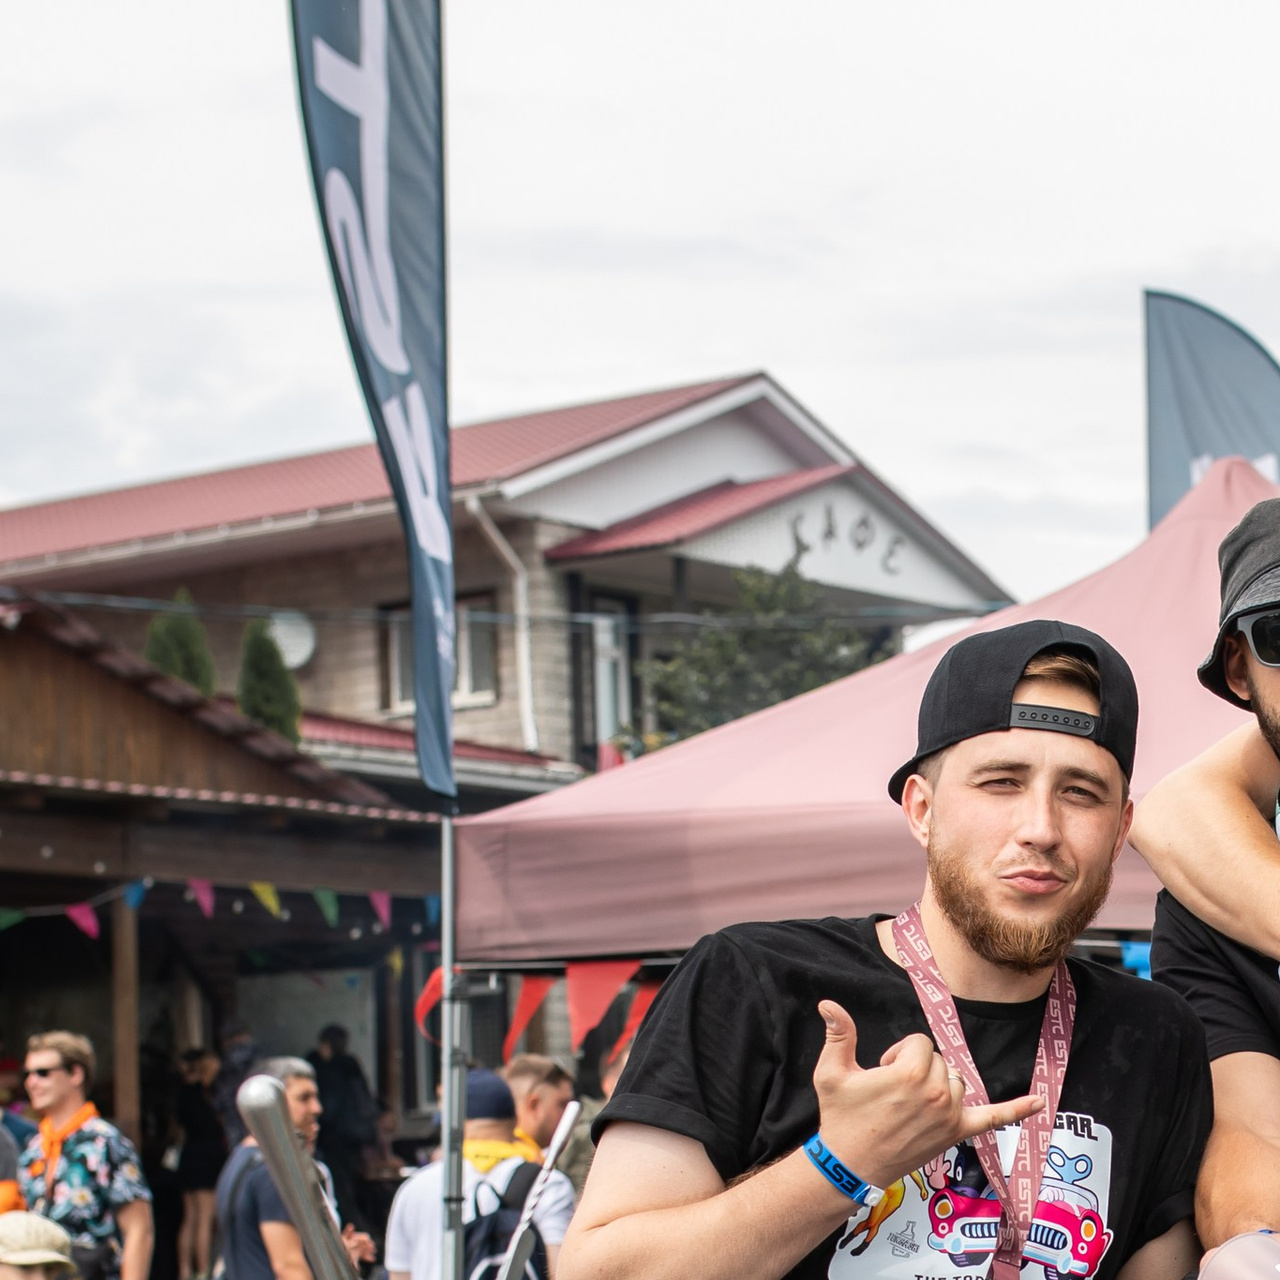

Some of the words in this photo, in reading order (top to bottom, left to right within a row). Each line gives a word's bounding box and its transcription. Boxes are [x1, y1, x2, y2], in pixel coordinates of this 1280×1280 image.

[902, 923, 932, 962] ESTC
[909, 970, 944, 1004] ESTC
[938, 1004, 966, 1047] ESTC
[1049, 998, 1065, 1036] ESTC
[1053, 1039, 1068, 1078] ESTC
[1036, 1081, 1051, 1126] ESTC
[808, 1139, 861, 1195] ESTC
[1017, 1128, 1032, 1172] ESTC
[1017, 1177, 1032, 1222] ESTC
